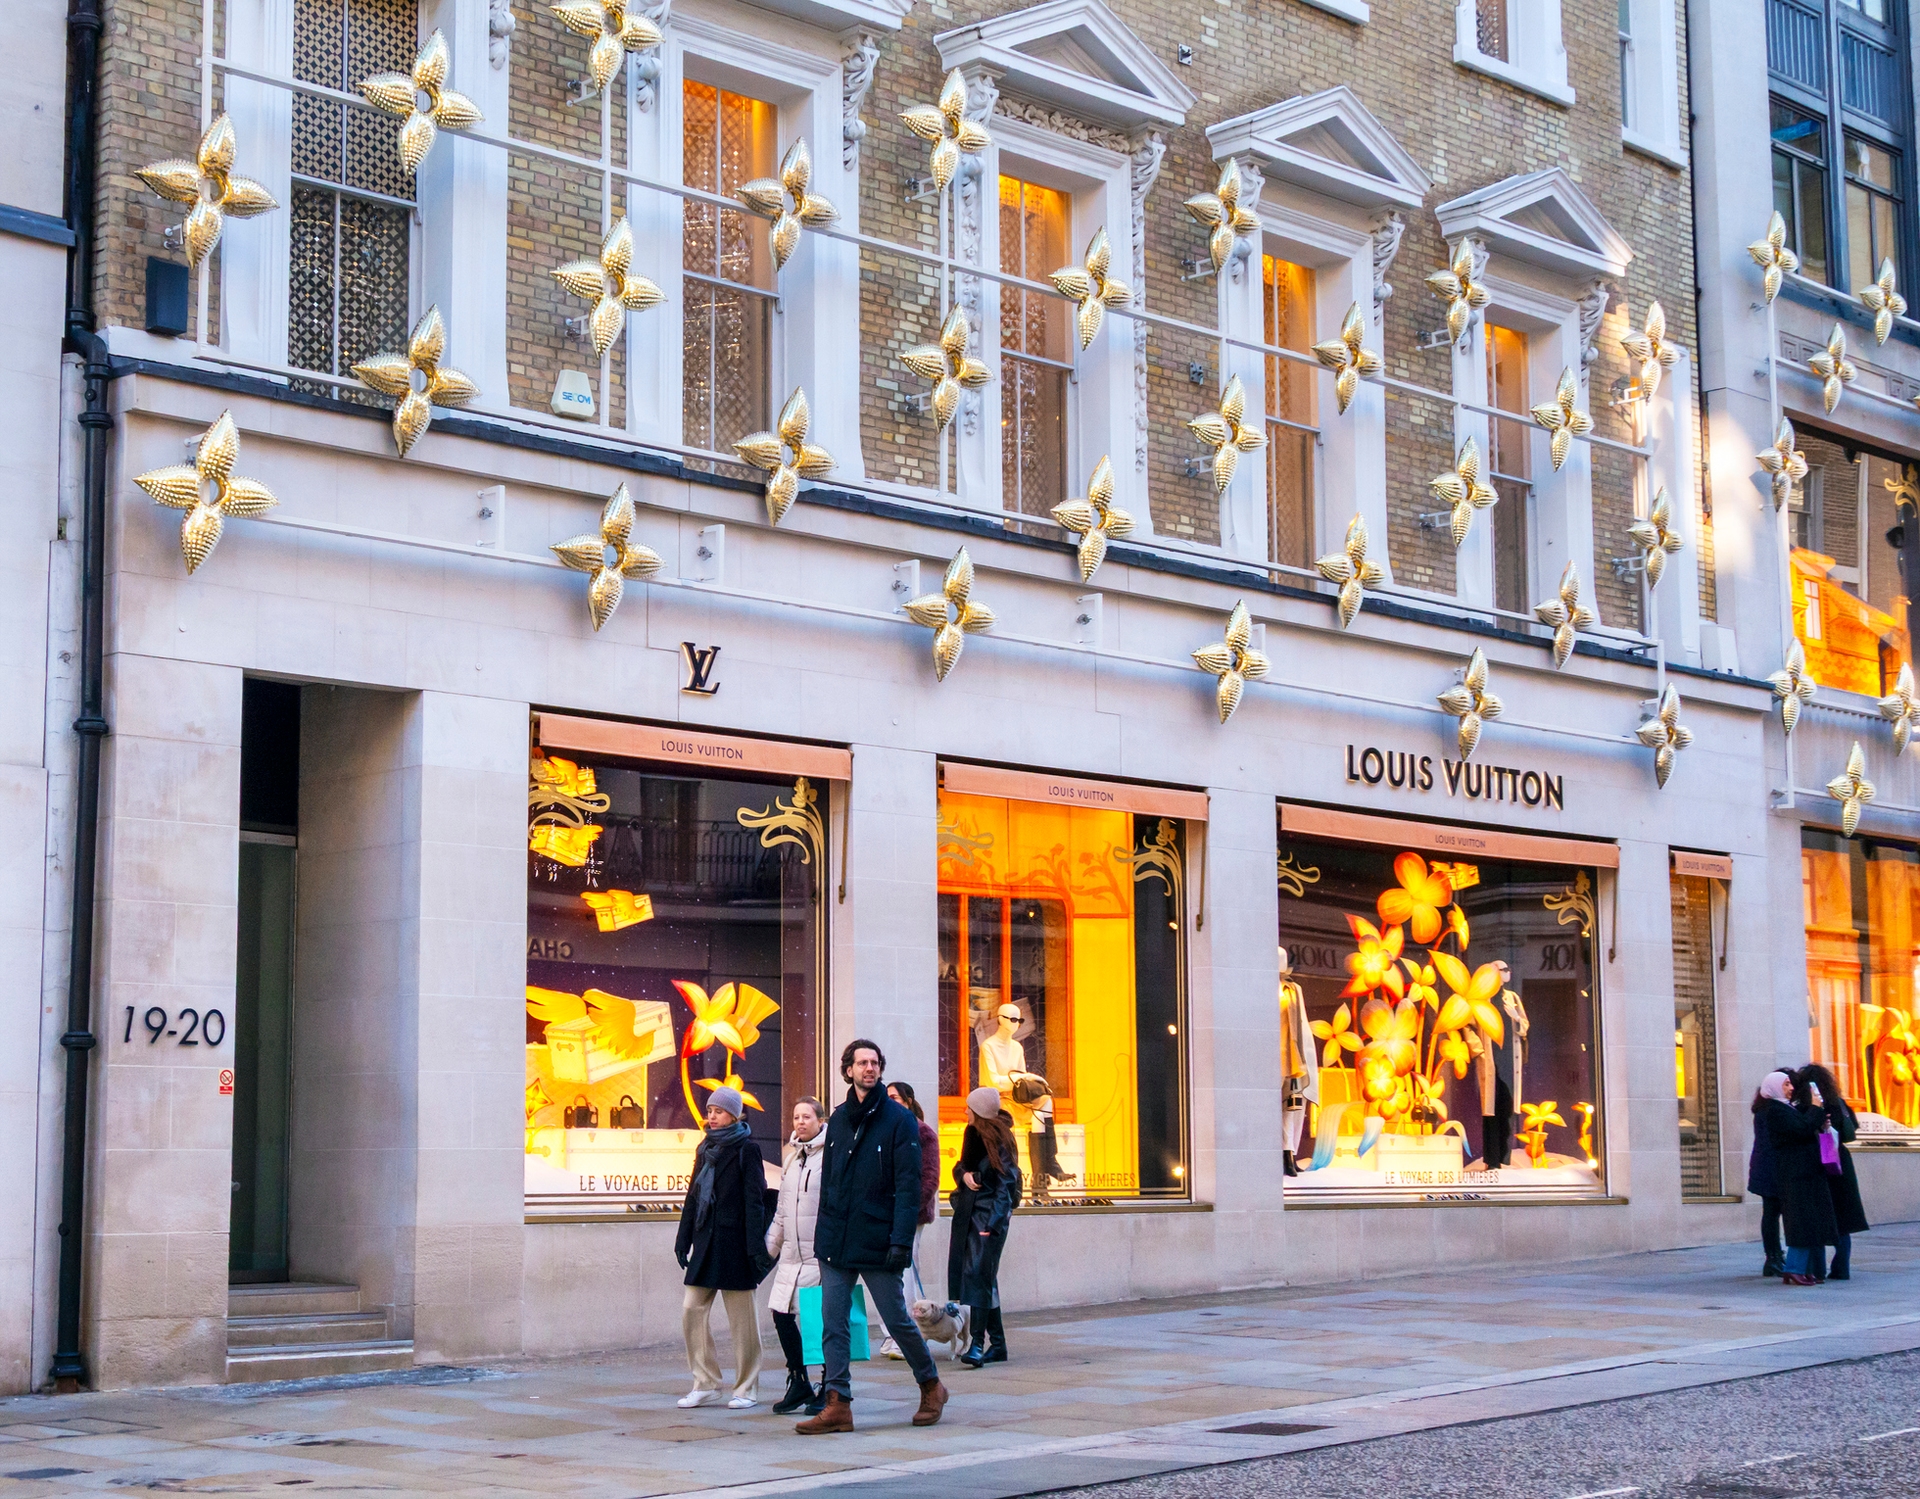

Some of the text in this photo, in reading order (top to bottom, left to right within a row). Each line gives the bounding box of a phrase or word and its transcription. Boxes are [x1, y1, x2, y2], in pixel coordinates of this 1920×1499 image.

[562, 391, 591, 404] SECOM
[661, 740, 743, 760] LOUIS VUITTON
[1345, 744, 1564, 811] LOUIS VUITTON
[1048, 785, 1114, 802] LOUIS VUITTON
[1435, 834, 1486, 848] LOUIS VUITTON
[123, 1005, 226, 1047] 19-20
[579, 1174, 692, 1191] LE VOYAGE DES
[1057, 1172, 1078, 1187] DES
[1083, 1172, 1135, 1187] LUMIERES
[1438, 1170, 1455, 1183] DES
